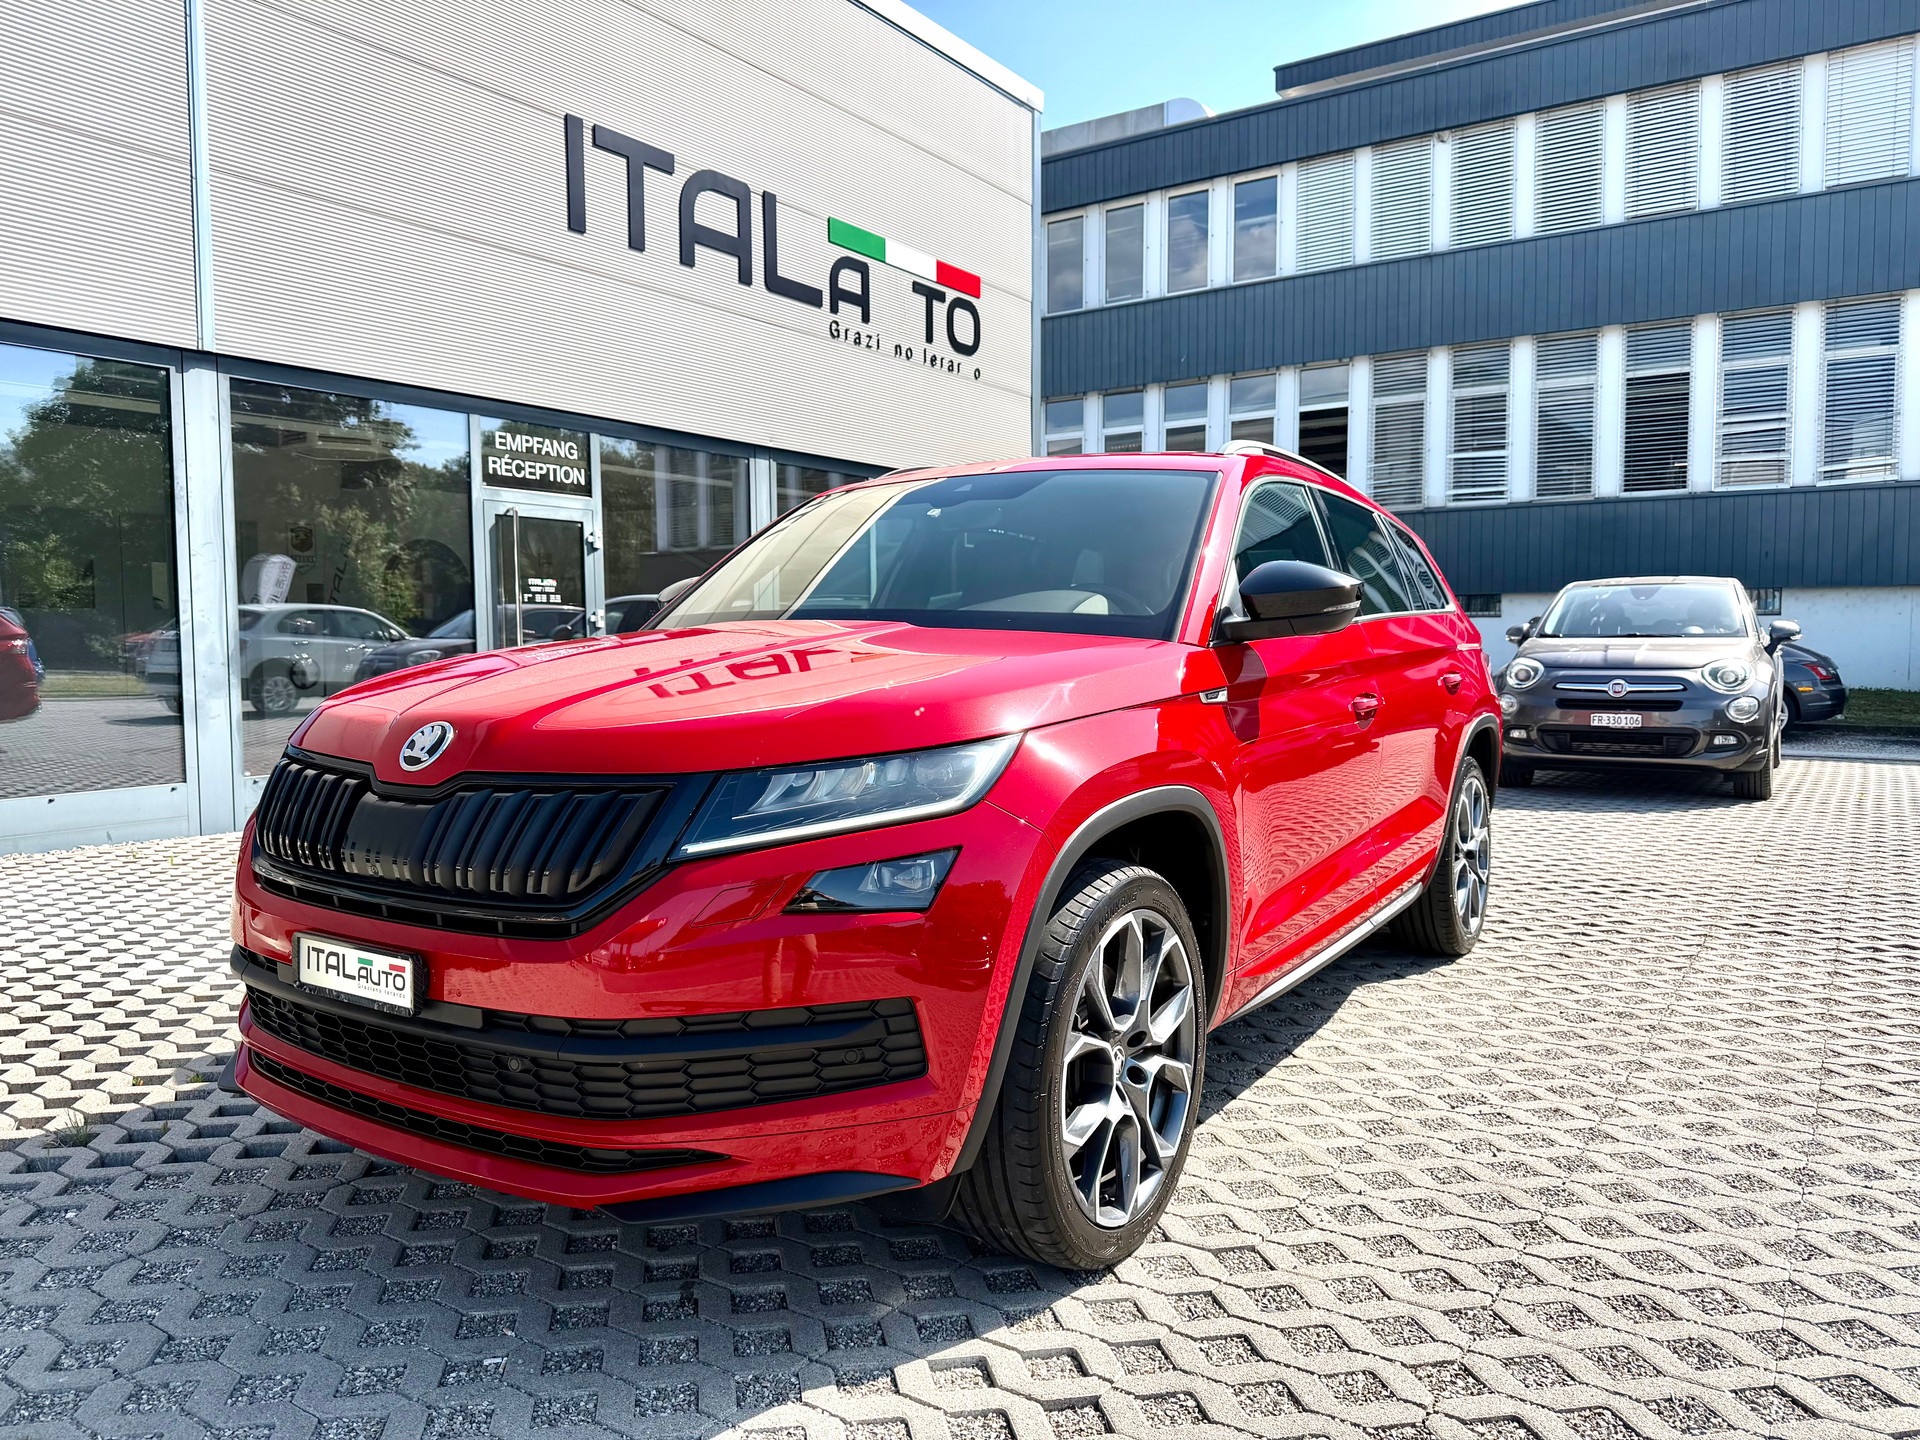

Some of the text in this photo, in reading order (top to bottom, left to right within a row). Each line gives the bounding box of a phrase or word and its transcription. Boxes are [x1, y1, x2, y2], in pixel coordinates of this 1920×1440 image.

[494, 431, 579, 460] EMPFANG
[487, 454, 586, 486] RÉCEPTION
[1624, 716, 1640, 726] 106
[306, 945, 406, 992] ITALAUTO
